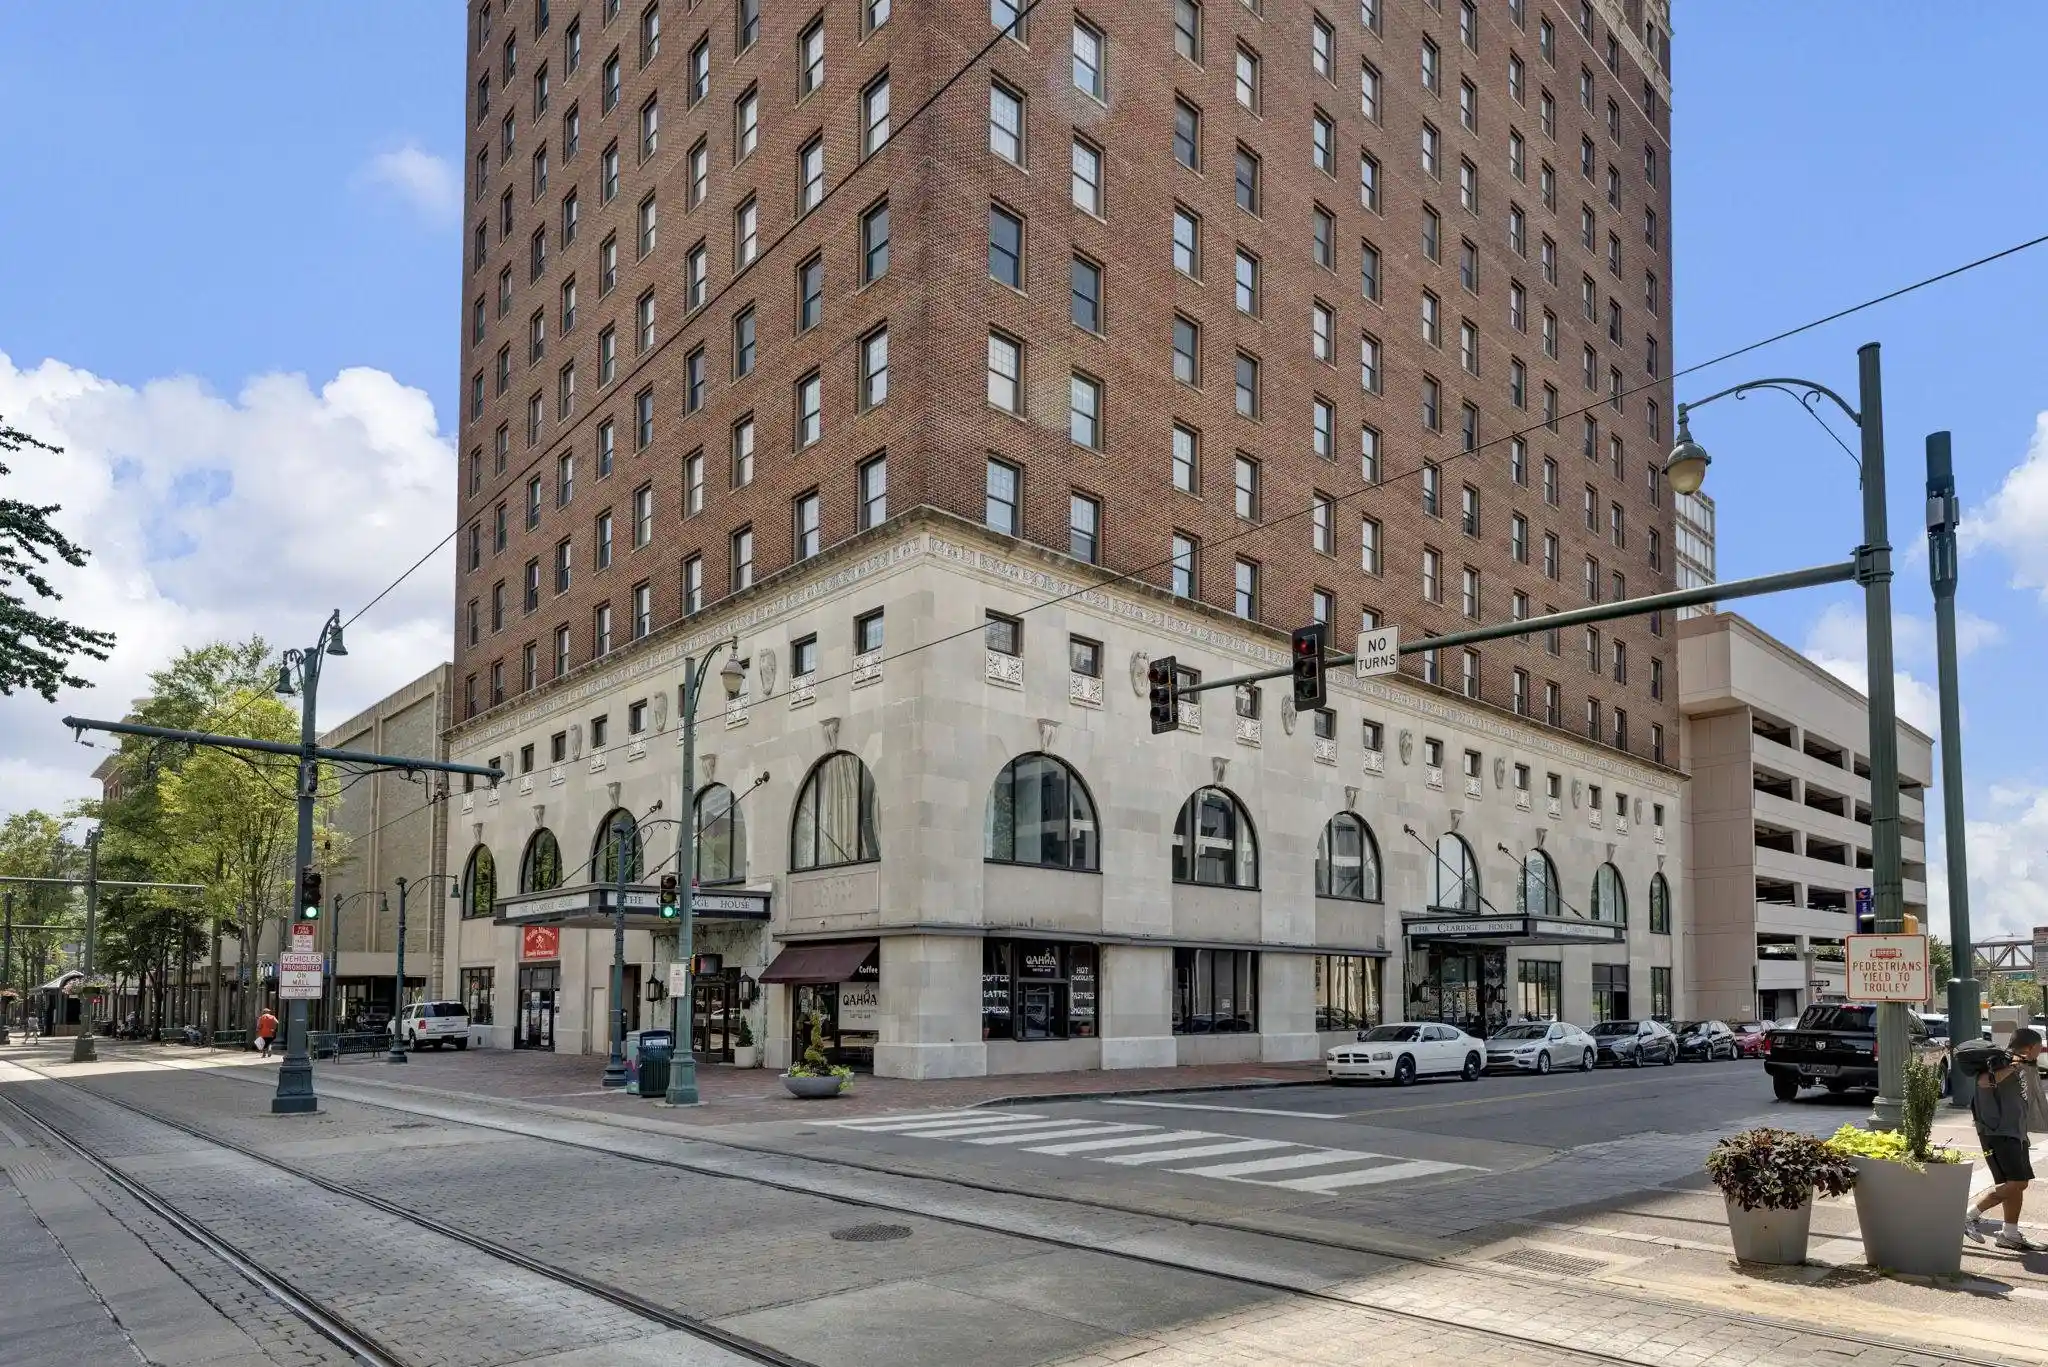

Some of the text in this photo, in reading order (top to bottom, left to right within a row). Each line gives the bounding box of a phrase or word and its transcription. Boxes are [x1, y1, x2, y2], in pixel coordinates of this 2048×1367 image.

[1368, 637, 1386, 653] NO
[1358, 654, 1395, 670] TURNS
[720, 899, 751, 909] HOUSE
[1414, 922, 1514, 934] THE CLARIDGE HOUSE
[284, 955, 320, 963] VEHICLES
[283, 963, 320, 971] PROHIBITED
[859, 966, 878, 974] Coffee
[1076, 966, 1089, 975] HOT
[1852, 961, 1922, 972] PEDESTRIANS
[981, 974, 1010, 982] COFFEE
[1862, 972, 1910, 982] YIELD TO
[1863, 982, 1909, 993] TROLLEY
[983, 990, 1008, 998] LATTE
[981, 1005, 1010, 1014] ESPRESSO
